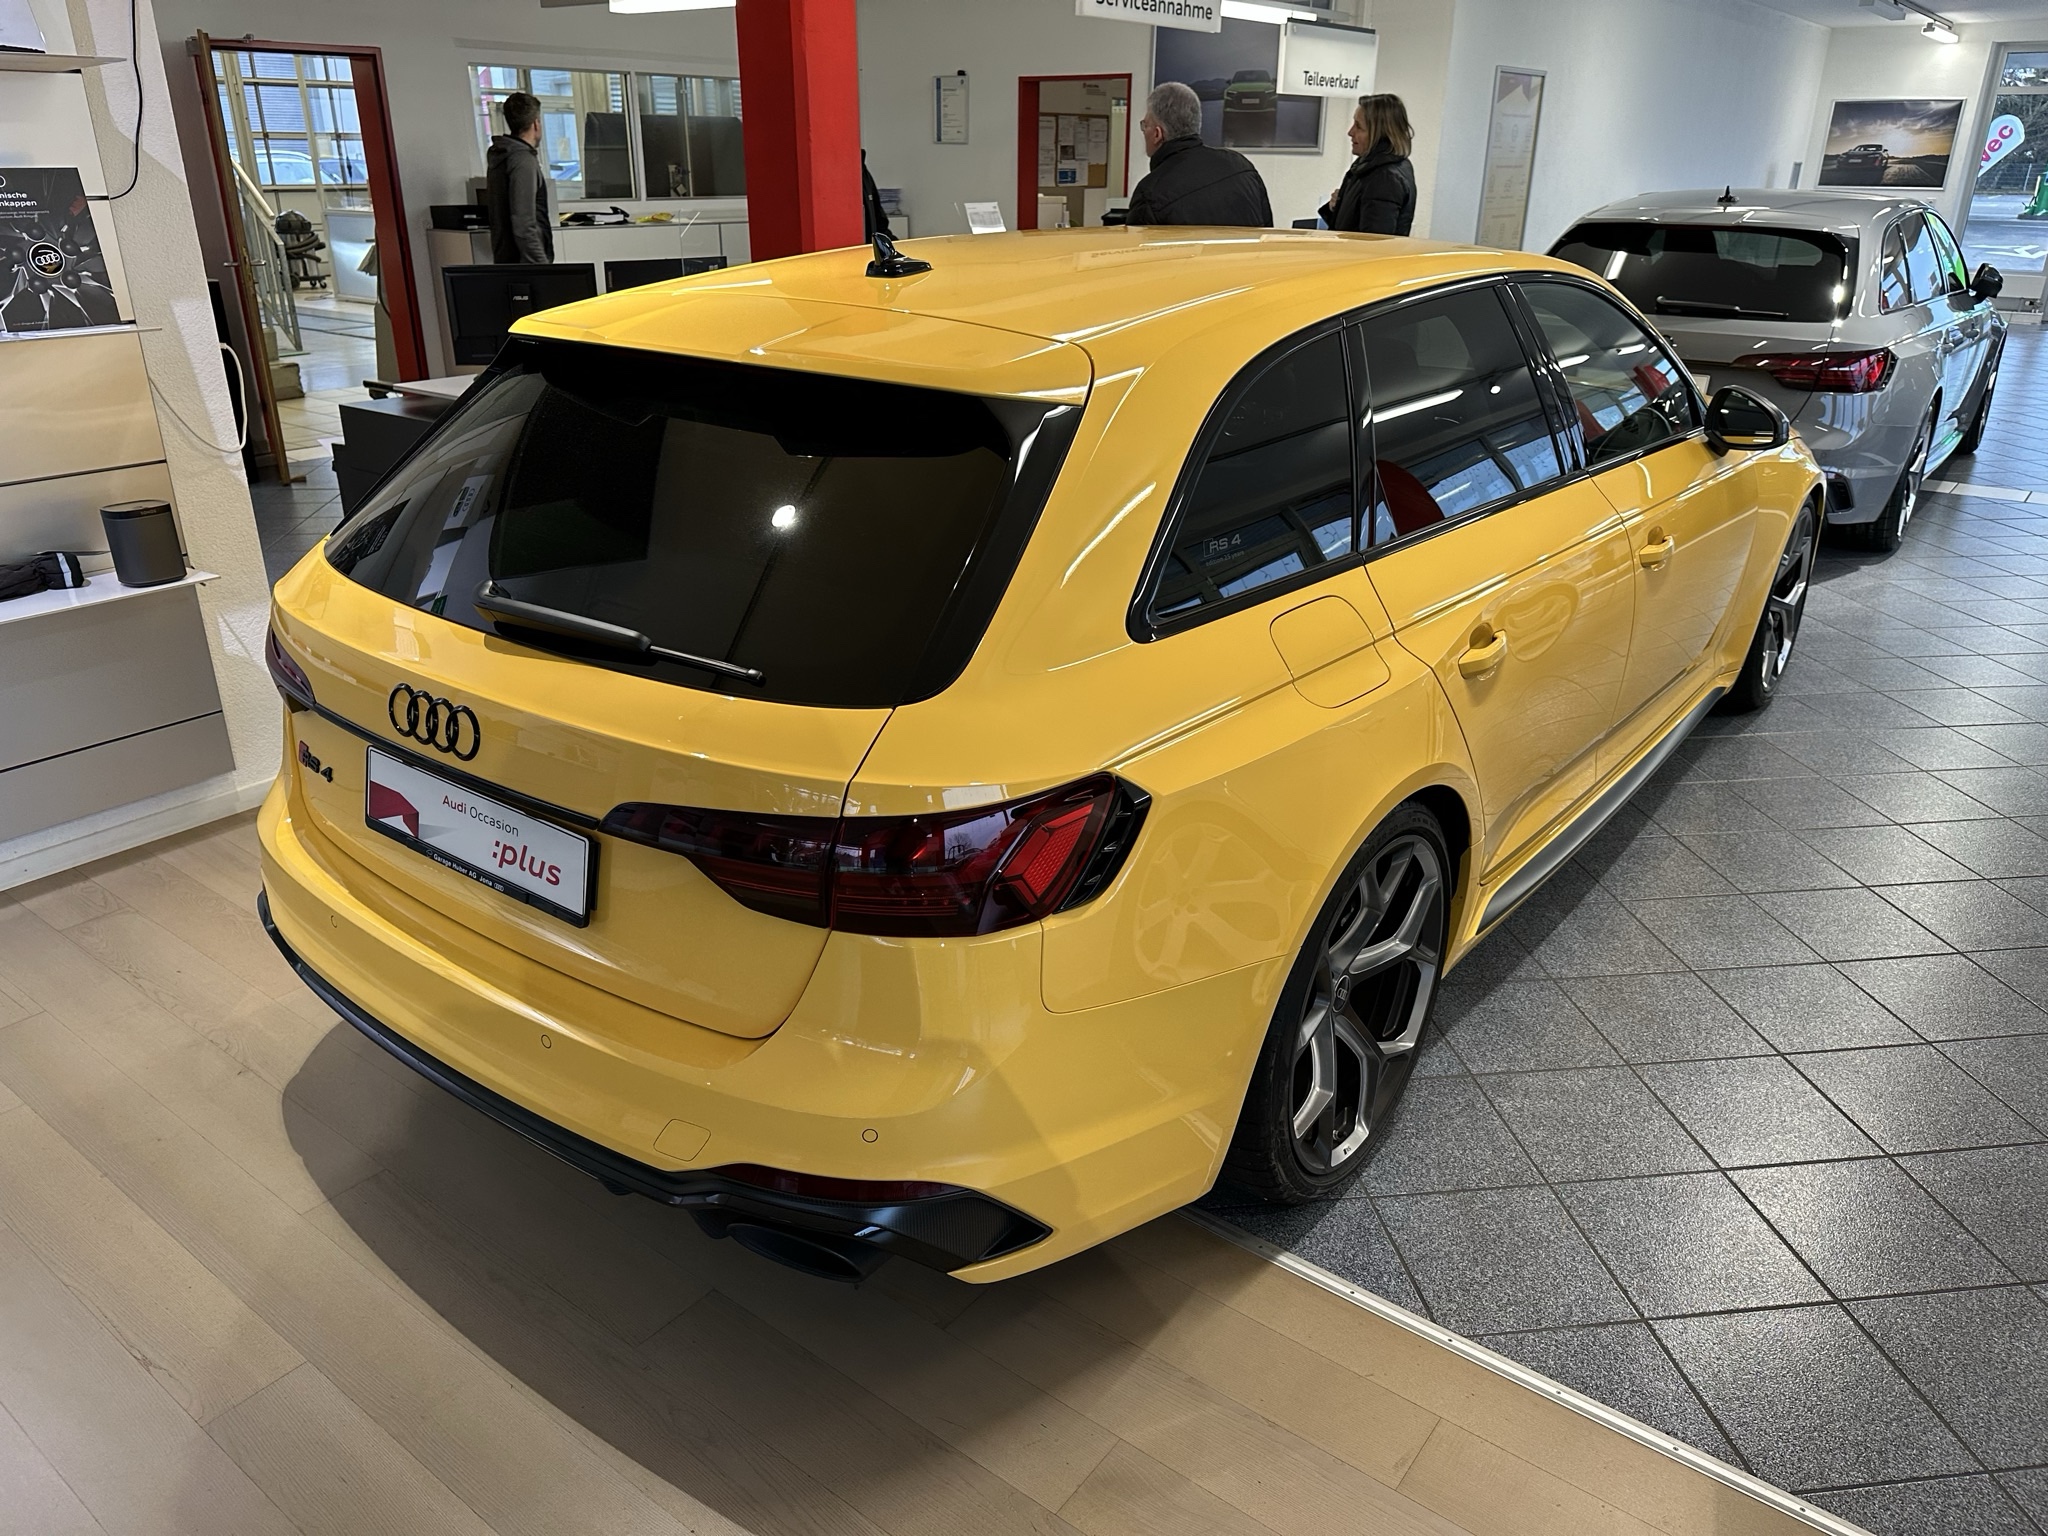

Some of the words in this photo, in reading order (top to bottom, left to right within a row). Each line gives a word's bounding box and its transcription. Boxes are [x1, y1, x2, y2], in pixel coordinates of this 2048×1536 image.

[1303, 70, 1360, 90] Teileverkauf
[1981, 124, 2014, 163] vec
[1206, 538, 1229, 555] RS
[1231, 533, 1242, 545] 4
[320, 766, 334, 783] 4
[442, 795, 467, 814] Audi
[469, 806, 519, 837] Occasion
[433, 853, 452, 868] Garage
[452, 863, 468, 874] Huber
[468, 870, 477, 879] AG
[492, 840, 562, 886] :plus
